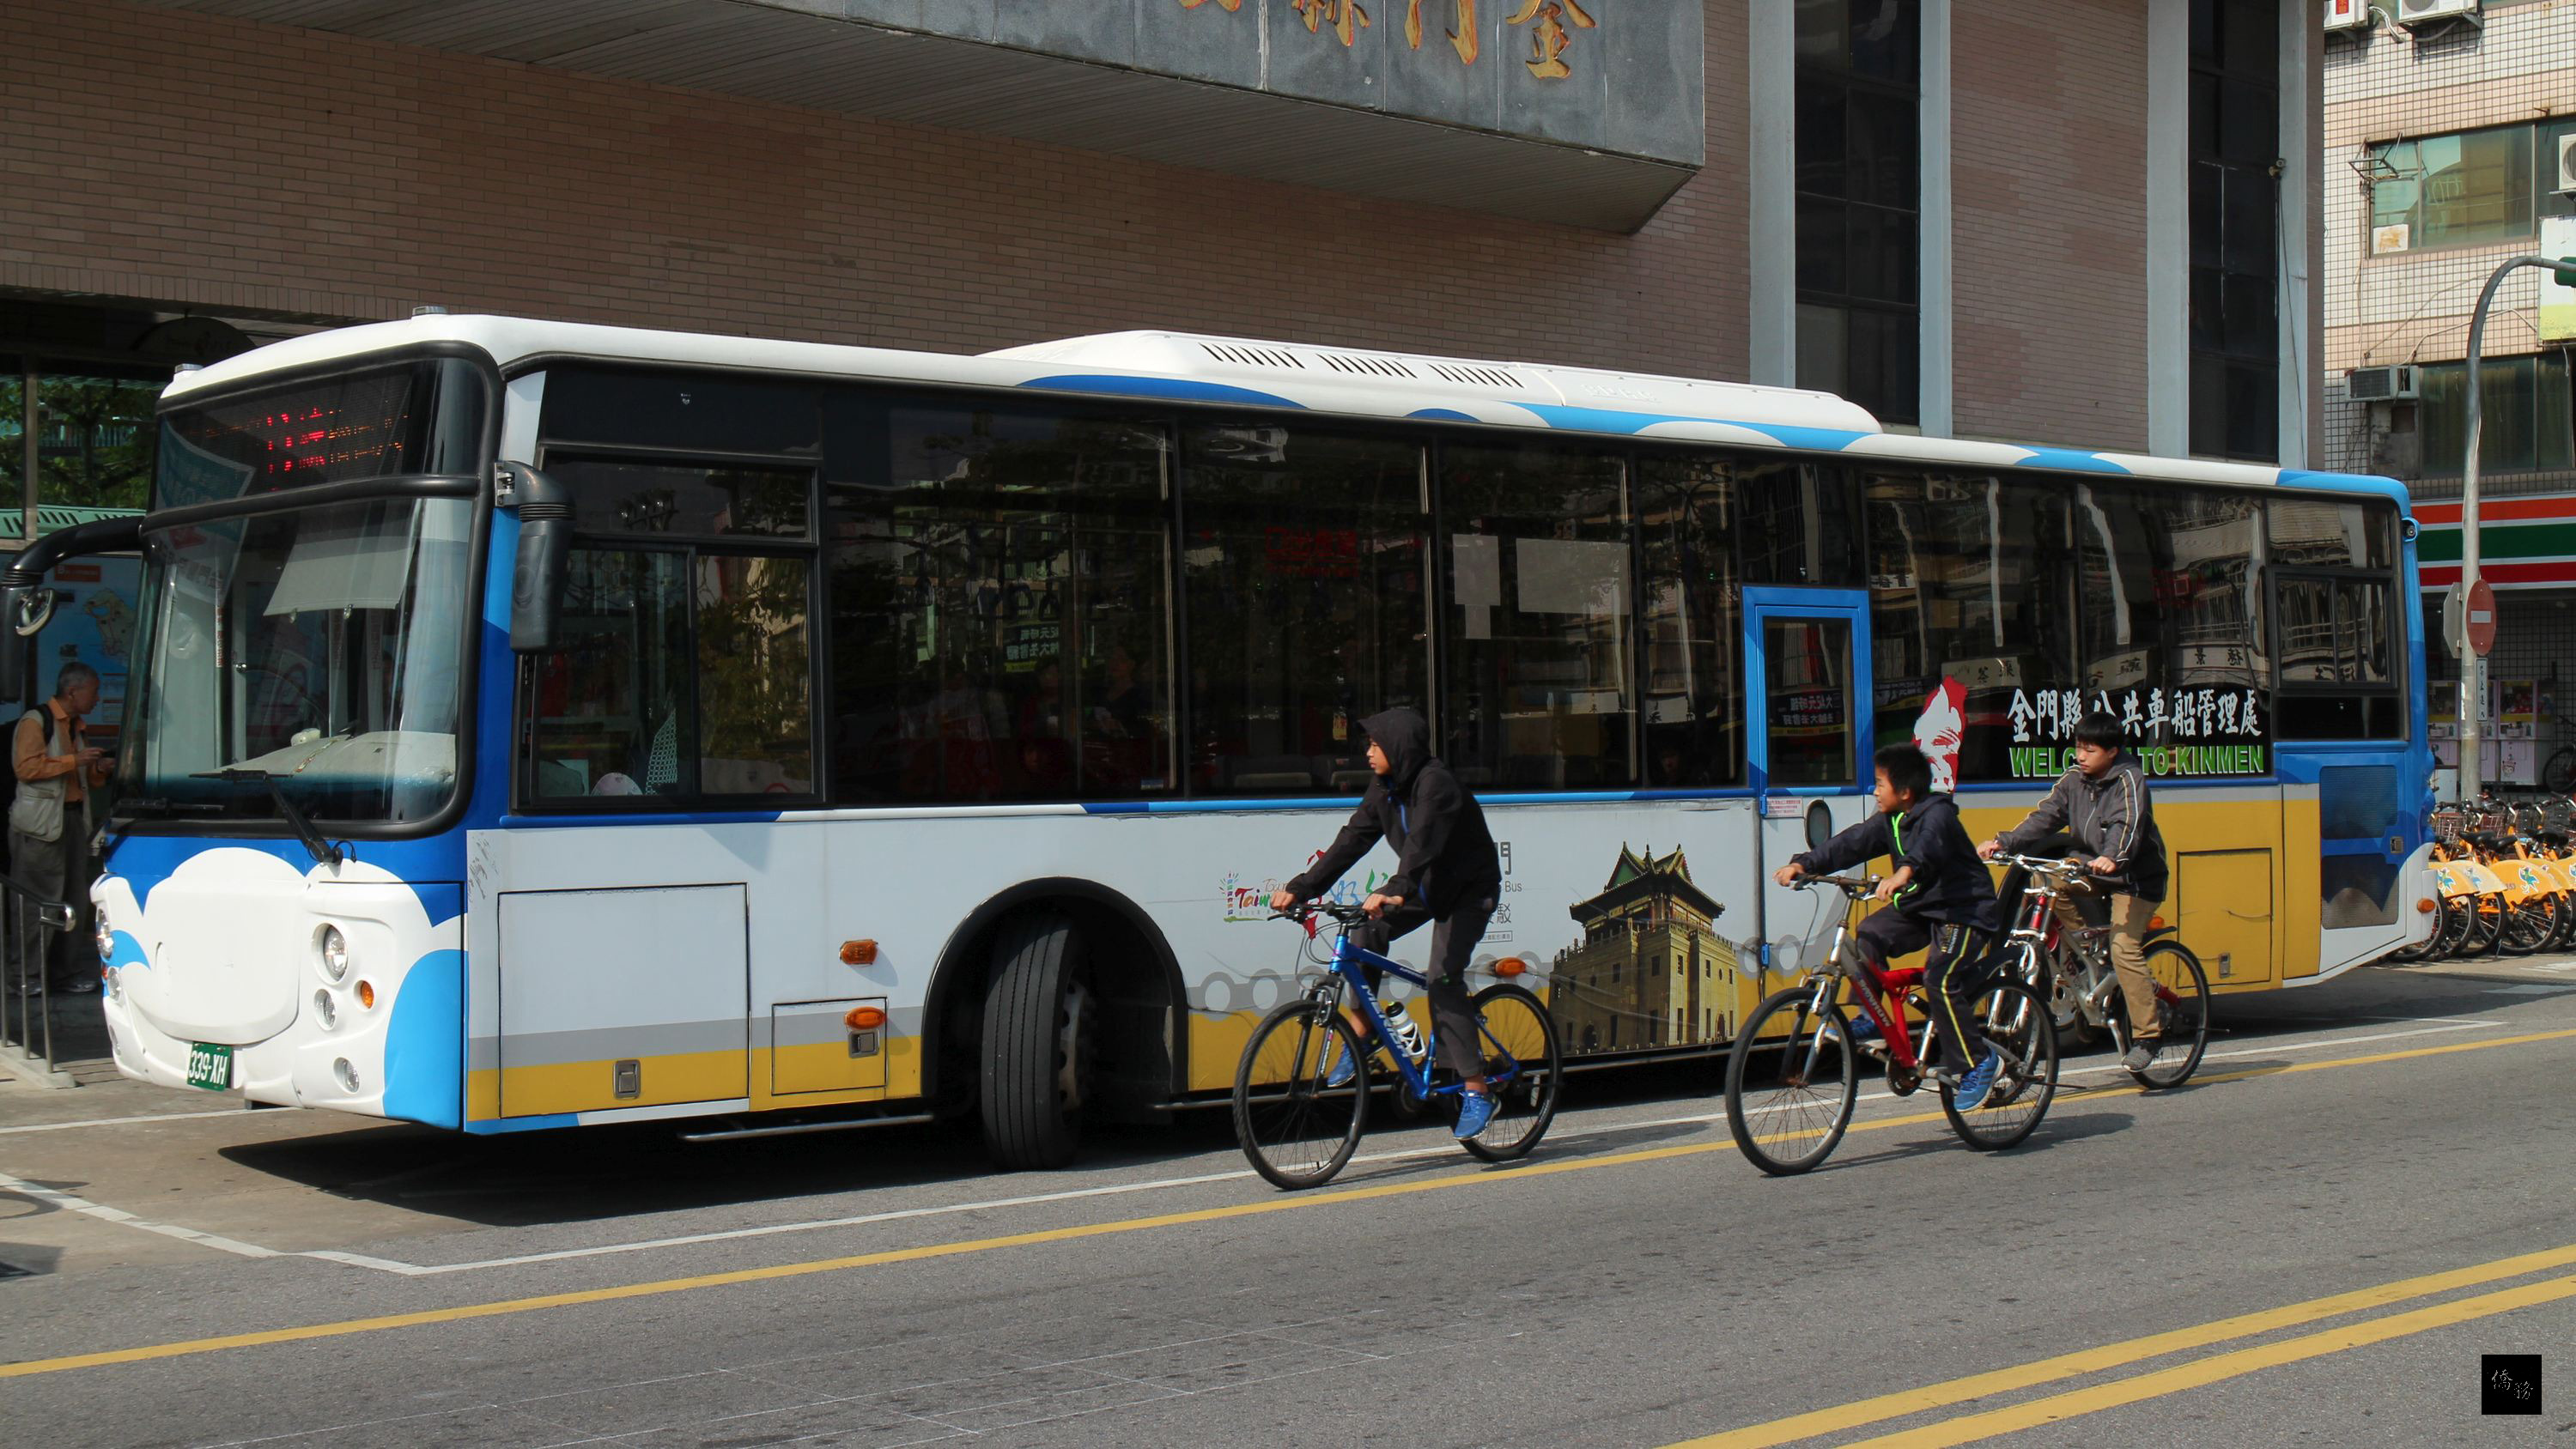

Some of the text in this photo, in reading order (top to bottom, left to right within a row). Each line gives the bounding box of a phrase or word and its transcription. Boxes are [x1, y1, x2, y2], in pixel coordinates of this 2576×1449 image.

[2008, 745, 2264, 777] WELC TO KINMEN
[1235, 888, 1271, 909] Taiw
[1504, 881, 1522, 893] Bus
[188, 1050, 228, 1085] 339-XH
